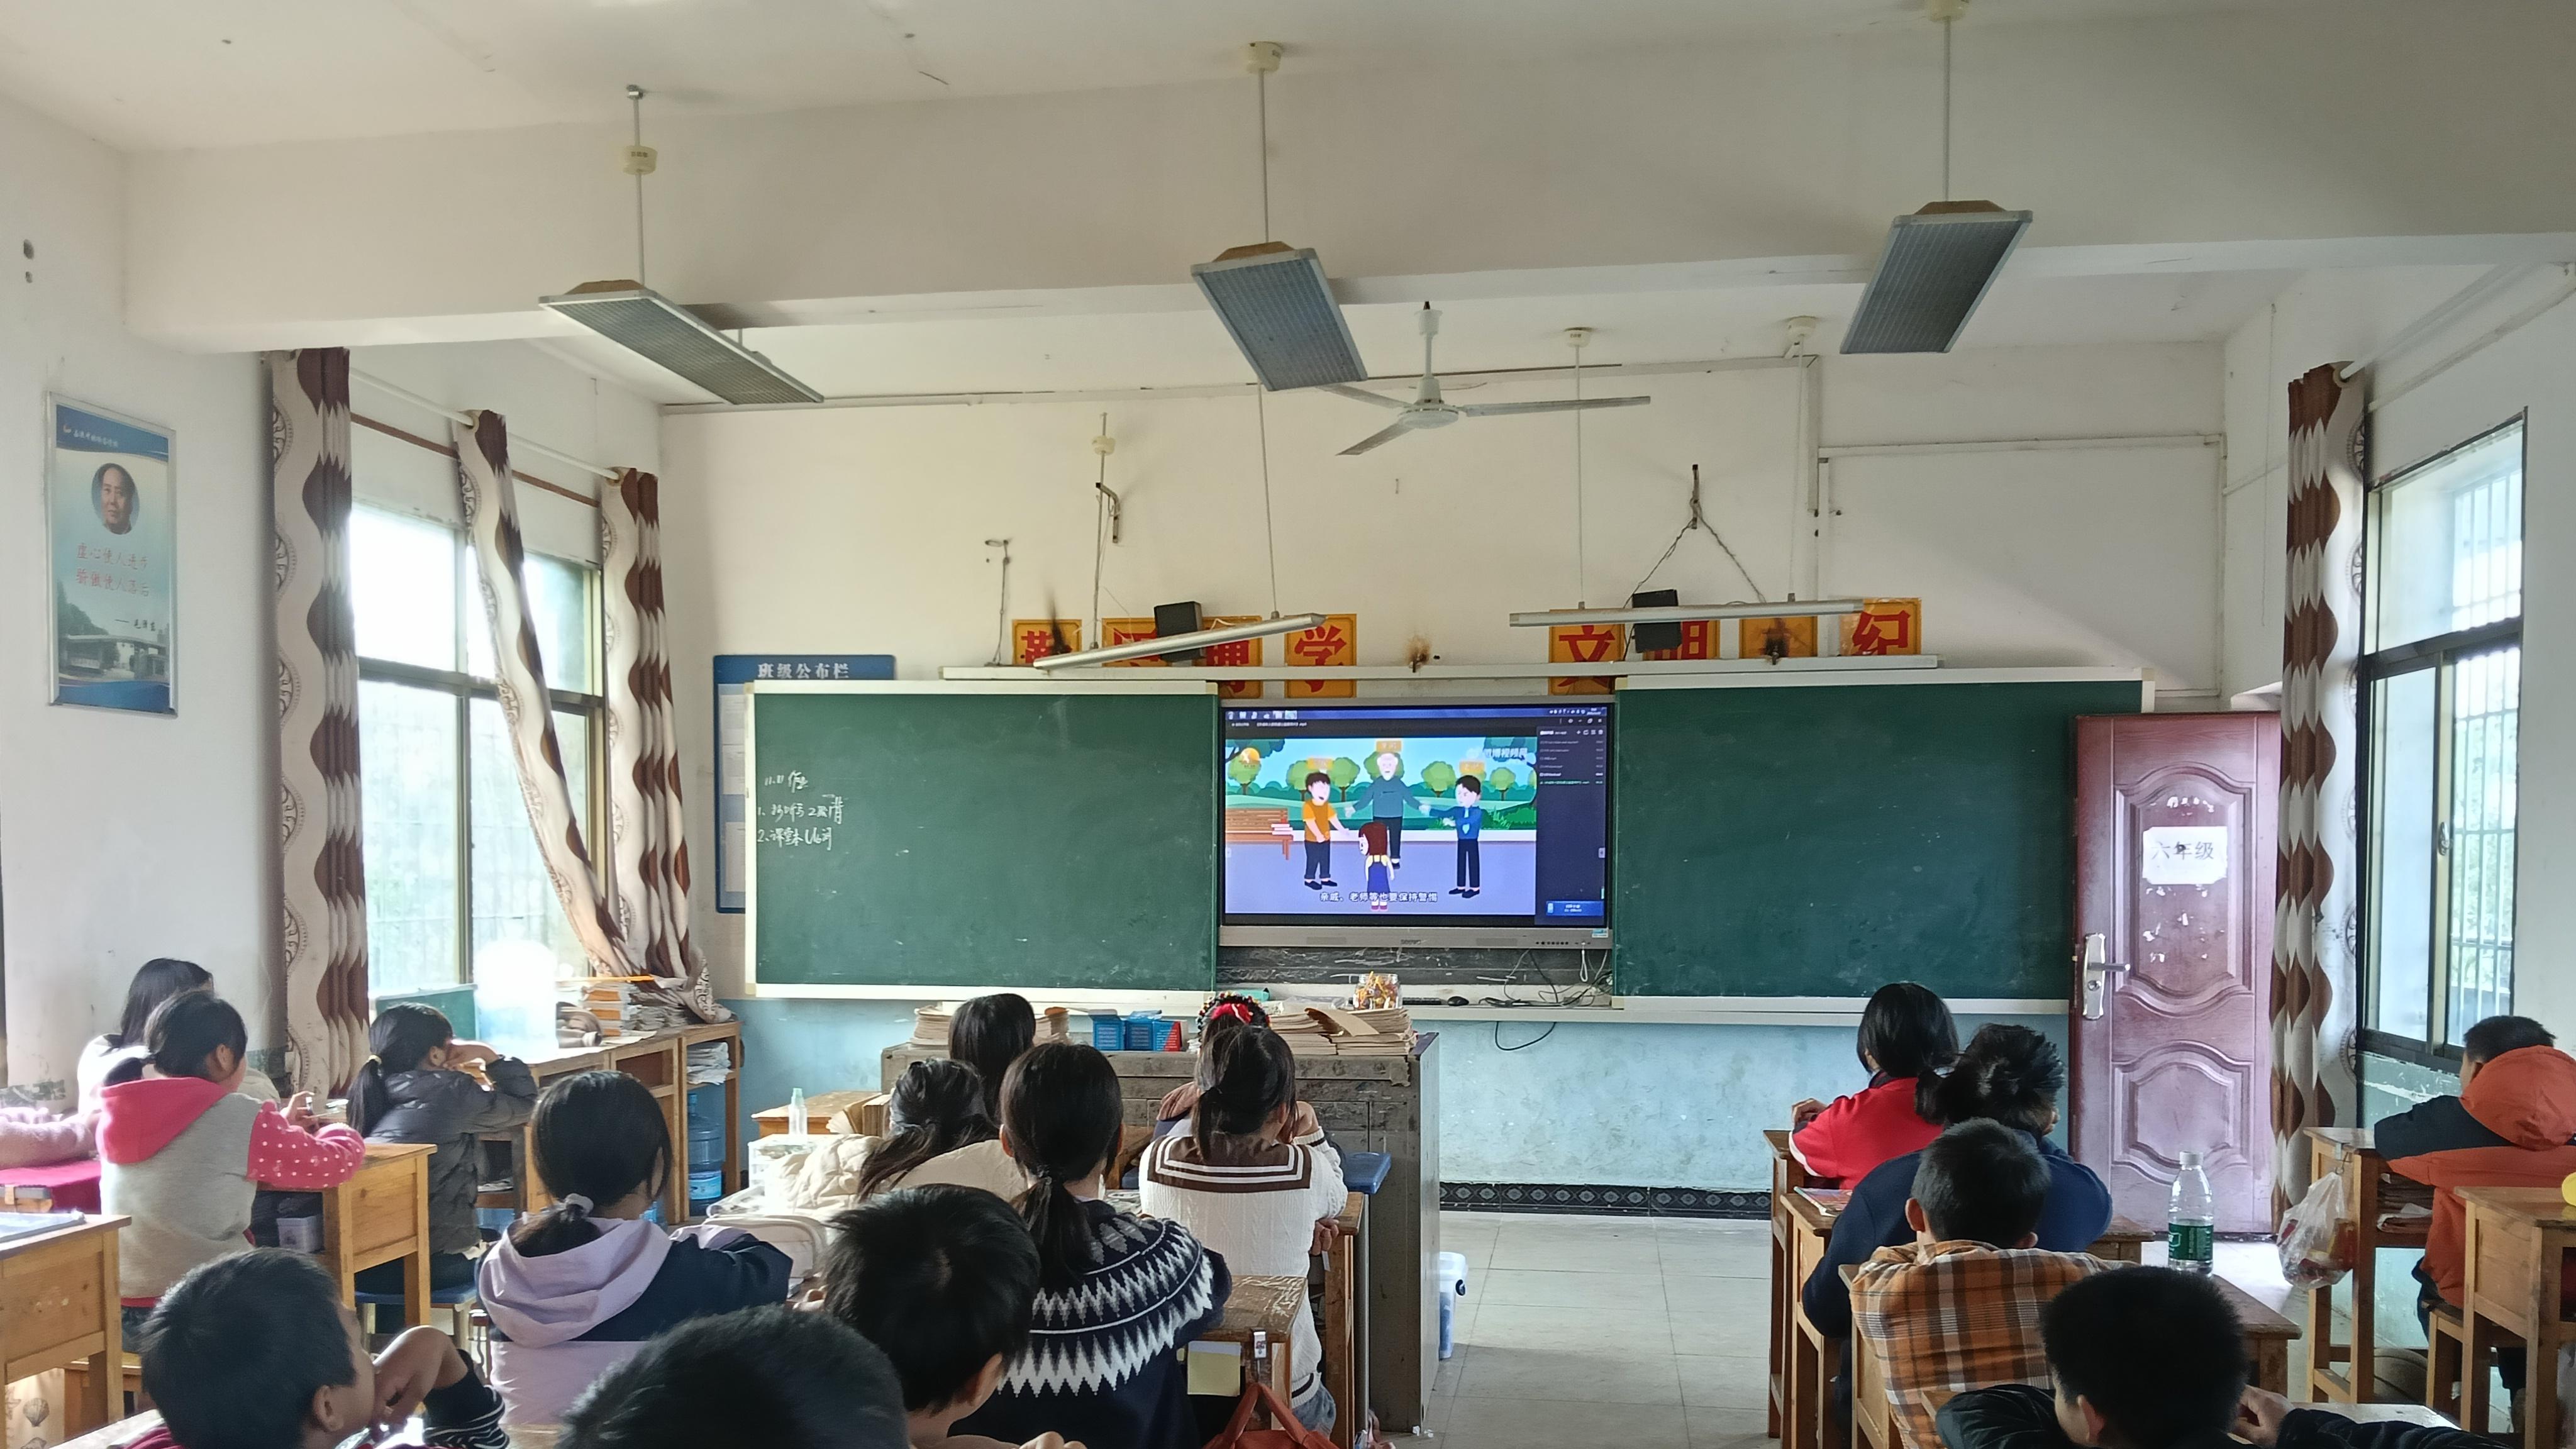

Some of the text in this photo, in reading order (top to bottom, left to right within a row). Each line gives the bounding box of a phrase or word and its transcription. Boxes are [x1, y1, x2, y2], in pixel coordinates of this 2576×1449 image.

[758, 663, 849, 679] 班级公布栏
[2151, 841, 2214, 860] 六年级
[1320, 892, 1438, 902] 亲戚、老师等也要保持警惕
